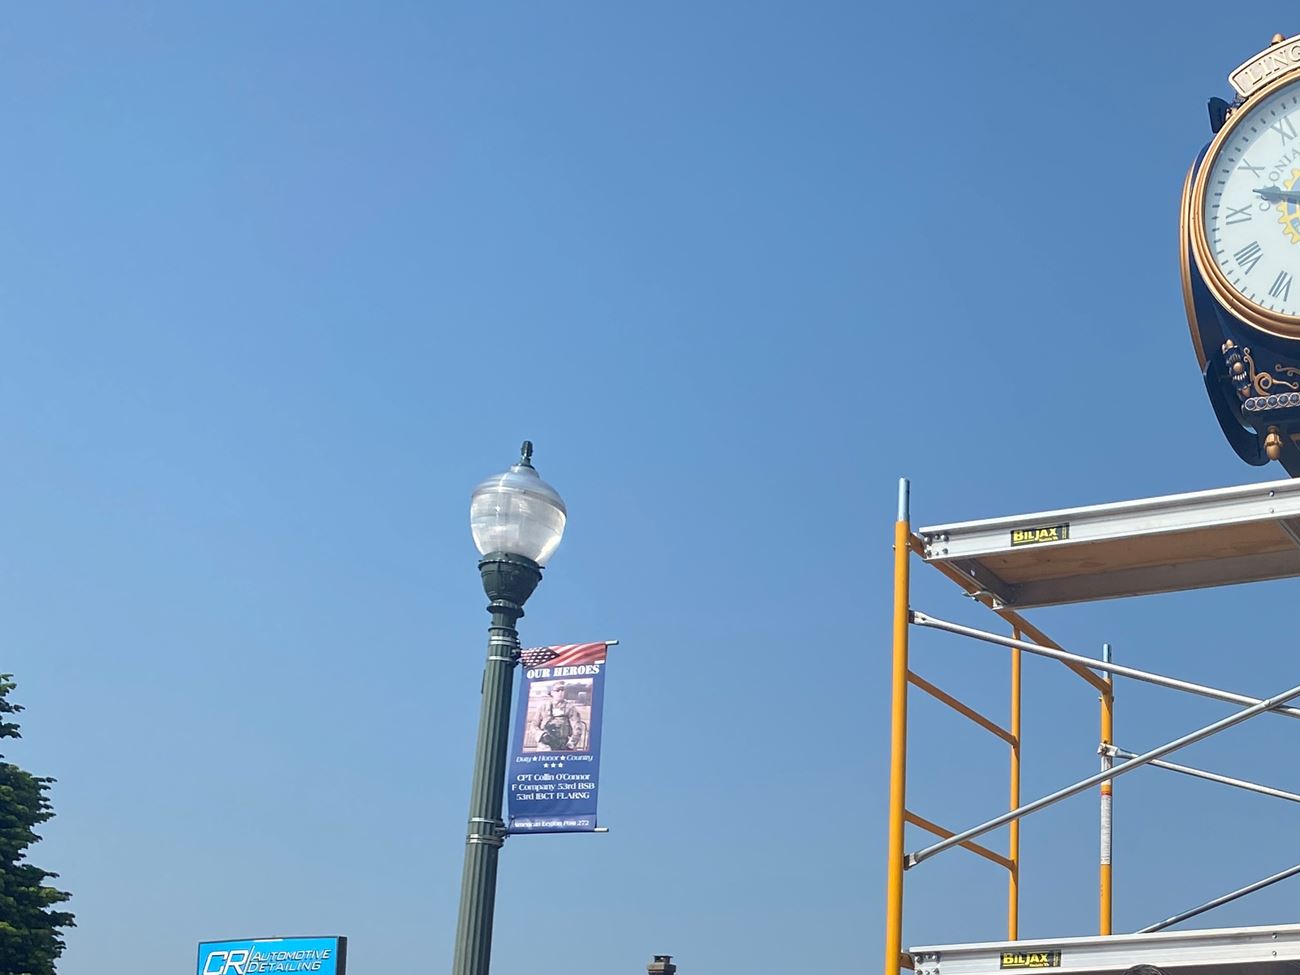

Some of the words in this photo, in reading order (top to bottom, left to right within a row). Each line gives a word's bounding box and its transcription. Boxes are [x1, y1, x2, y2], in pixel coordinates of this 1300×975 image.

[1270, 115, 1298, 146] XI
[1237, 159, 1266, 178] X
[1225, 204, 1253, 225] IX
[526, 667, 551, 679] OUR
[553, 664, 600, 677] HEROES
[566, 754, 594, 762] Country
[517, 774, 533, 782] CPT
[556, 773, 590, 781] O'Connor
[519, 783, 556, 792] Company
[578, 782, 595, 790] BSB
[516, 793, 534, 801] 53rd
[557, 792, 590, 800] FLARNG
[577, 819, 590, 827] 272
[250, 949, 333, 963] AUTOMOTIVE
[247, 960, 322, 974] DETAILING
